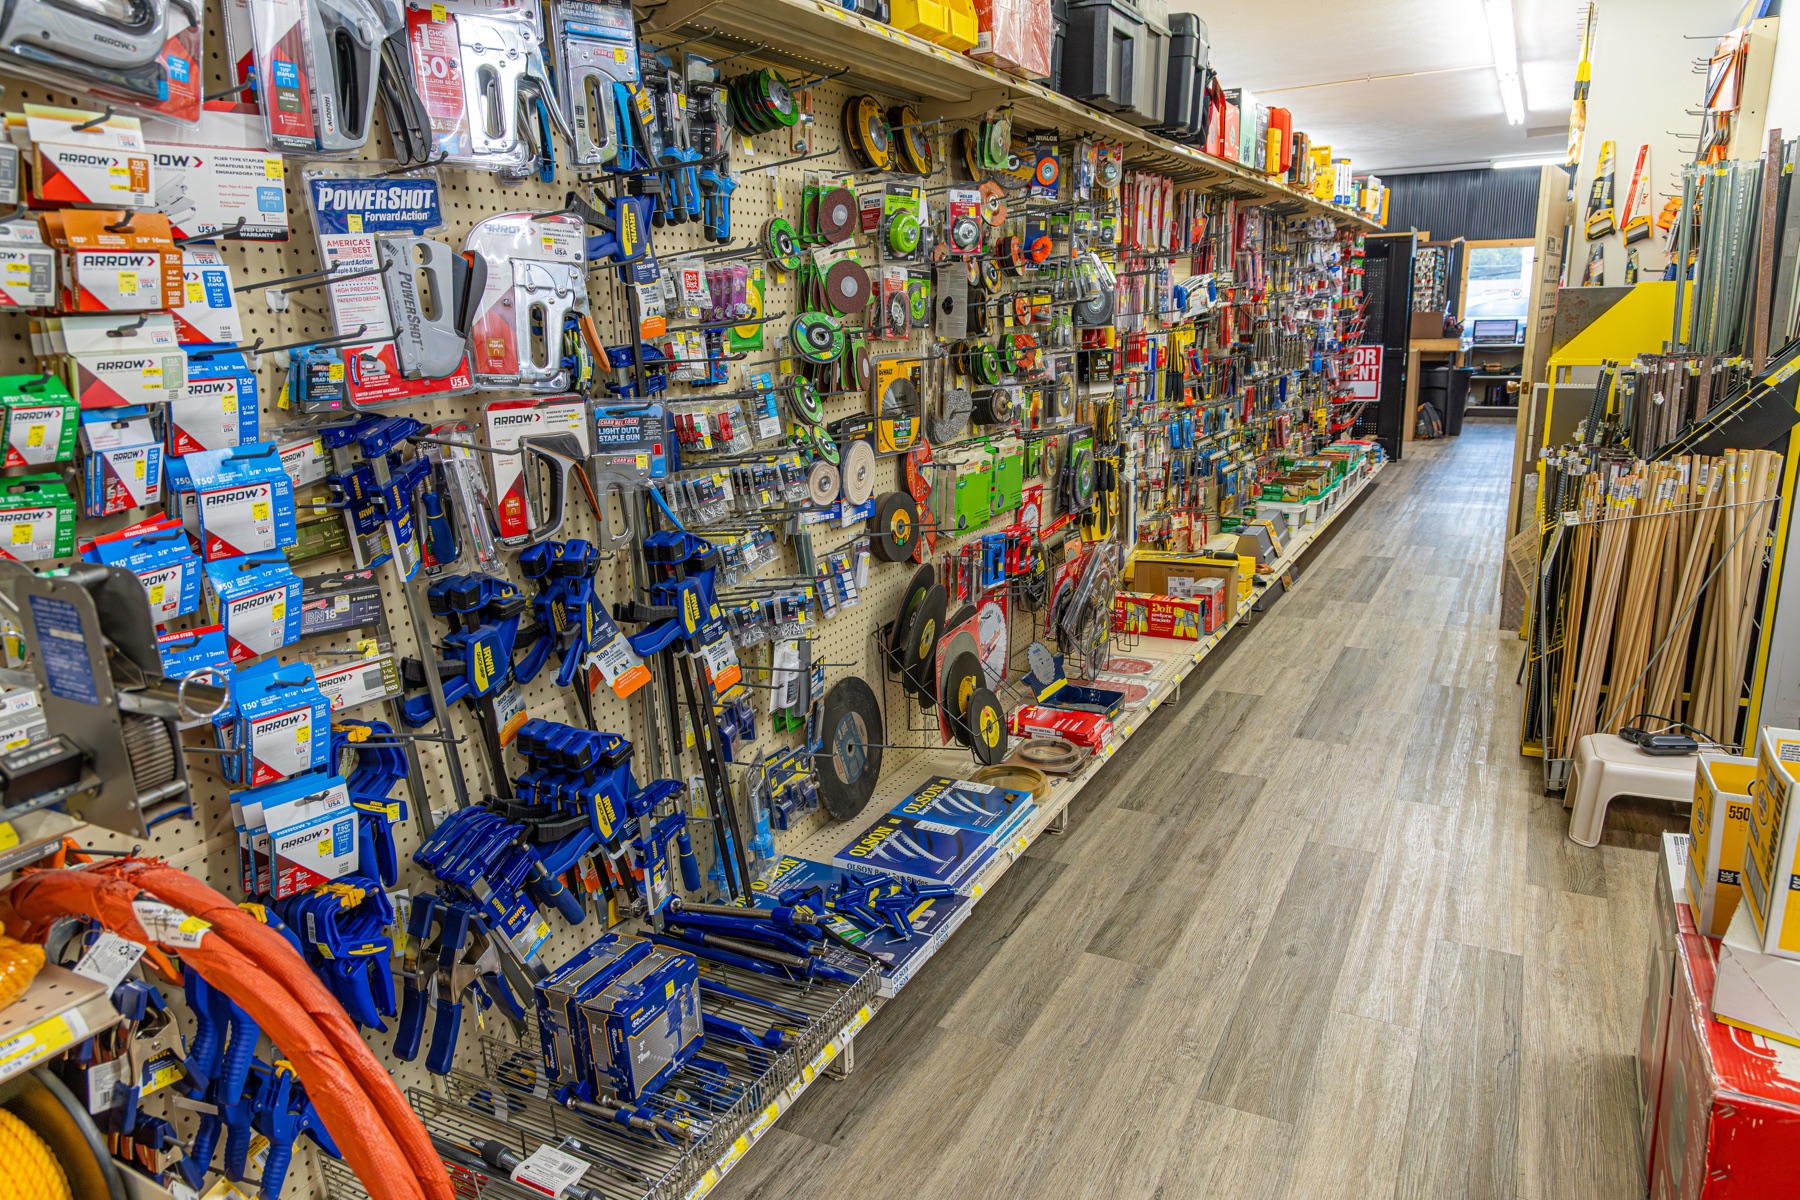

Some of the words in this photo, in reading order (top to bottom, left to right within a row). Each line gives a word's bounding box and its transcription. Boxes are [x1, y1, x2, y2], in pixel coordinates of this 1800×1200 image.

[94, 34, 130, 51] ARROW
[418, 56, 448, 78] 50
[324, 96, 333, 126] ARROW
[1035, 134, 1058, 142] NYALOX
[58, 153, 110, 166] ARROW
[317, 187, 434, 211] POWERSHOT
[365, 212, 400, 222] Forward
[401, 212, 428, 222] Action
[628, 212, 638, 244] IRWIN
[327, 239, 371, 247] AMERICA'S
[83, 255, 145, 267] ARROW
[399, 271, 423, 351] POWERSHOT
[1353, 349, 1377, 365] OR
[96, 359, 147, 372] ARROW
[1352, 365, 1379, 381] ENT
[239, 377, 254, 385] T50
[451, 377, 470, 387] USA
[188, 383, 225, 394] RROW
[14, 410, 54, 421] ARROW
[494, 414, 533, 426] ARROW
[598, 427, 620, 436] LIGHT
[621, 426, 640, 435] DUTY
[599, 435, 623, 443] STAPLE
[112, 451, 140, 462] ARROW
[281, 451, 302, 465] ARROW
[175, 478, 191, 486] T50
[196, 476, 216, 486] T50
[351, 475, 360, 500] IRWIN
[206, 489, 258, 506] ARROW
[393, 485, 402, 510] IRWIN
[232, 592, 276, 613] ARROW
[690, 593, 700, 620] IRWIN
[1152, 603, 1165, 613] Do
[180, 630, 194, 639] STEEL
[188, 653, 202, 662] 1/2"
[206, 650, 225, 659] 12mm
[482, 644, 496, 677] IRWIN
[596, 650, 610, 661] 300
[318, 674, 347, 689] ARROW
[386, 684, 398, 692] 1000
[15, 701, 30, 710] USA
[242, 700, 258, 711] T50
[256, 713, 300, 735] ARROW
[782, 757, 795, 769] IRWIN
[328, 800, 340, 808] USA
[903, 784, 945, 813] OLSON
[602, 795, 617, 823] IRWIN
[1728, 805, 1751, 821] 550
[277, 823, 305, 836] ARROW
[337, 824, 350, 832] T50
[1765, 781, 1787, 887] PENNZOIL
[281, 830, 322, 851] ARROW
[849, 826, 894, 857] OLSON
[847, 863, 873, 875] OLSON
[1720, 869, 1734, 883] SAE
[491, 897, 507, 916] IRWIN
[507, 905, 526, 926] IRWIN
[935, 921, 950, 940] OLSON
[893, 965, 909, 984] OLSON
[630, 1006, 644, 1020] IRWIN
